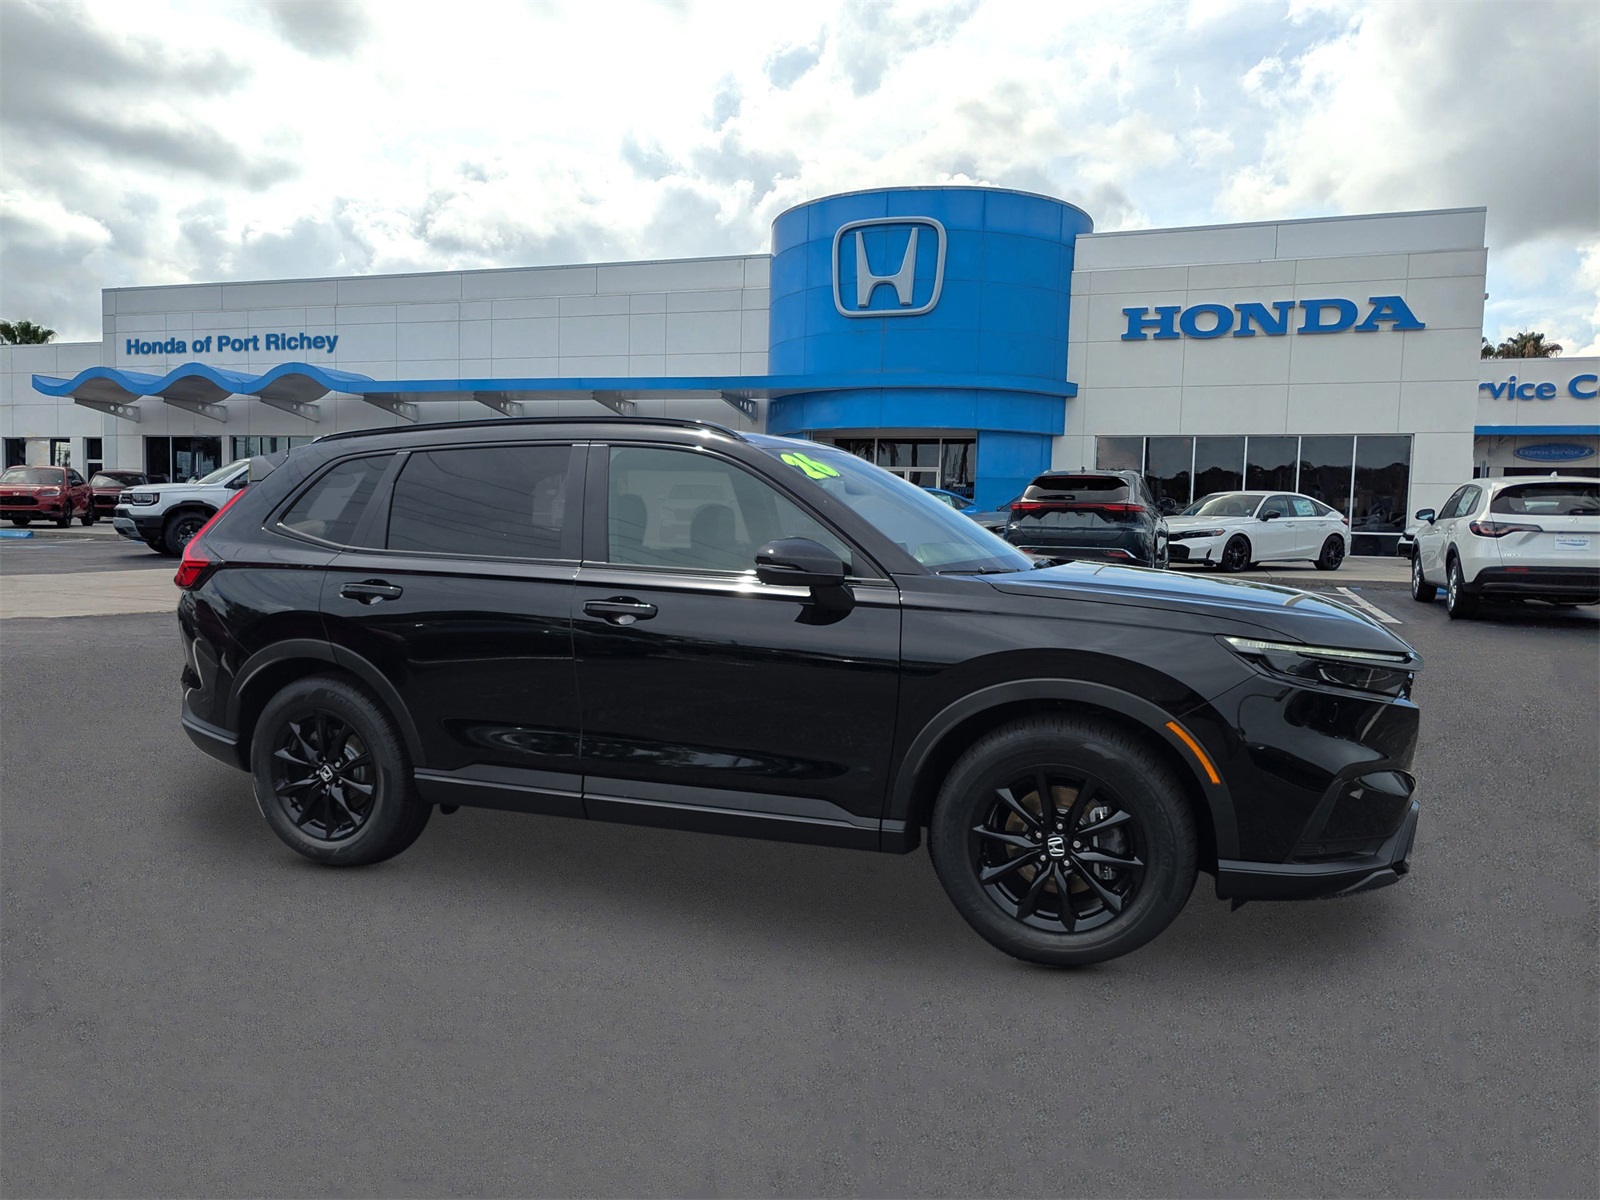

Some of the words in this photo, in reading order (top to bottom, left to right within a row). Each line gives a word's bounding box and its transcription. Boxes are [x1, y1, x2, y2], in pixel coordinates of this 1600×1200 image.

[1121, 295, 1426, 341] HONDA
[126, 337, 187, 355] Honda
[191, 336, 212, 353] of
[217, 334, 259, 352] Port
[265, 332, 339, 353] Richey
[780, 452, 840, 480] 26
